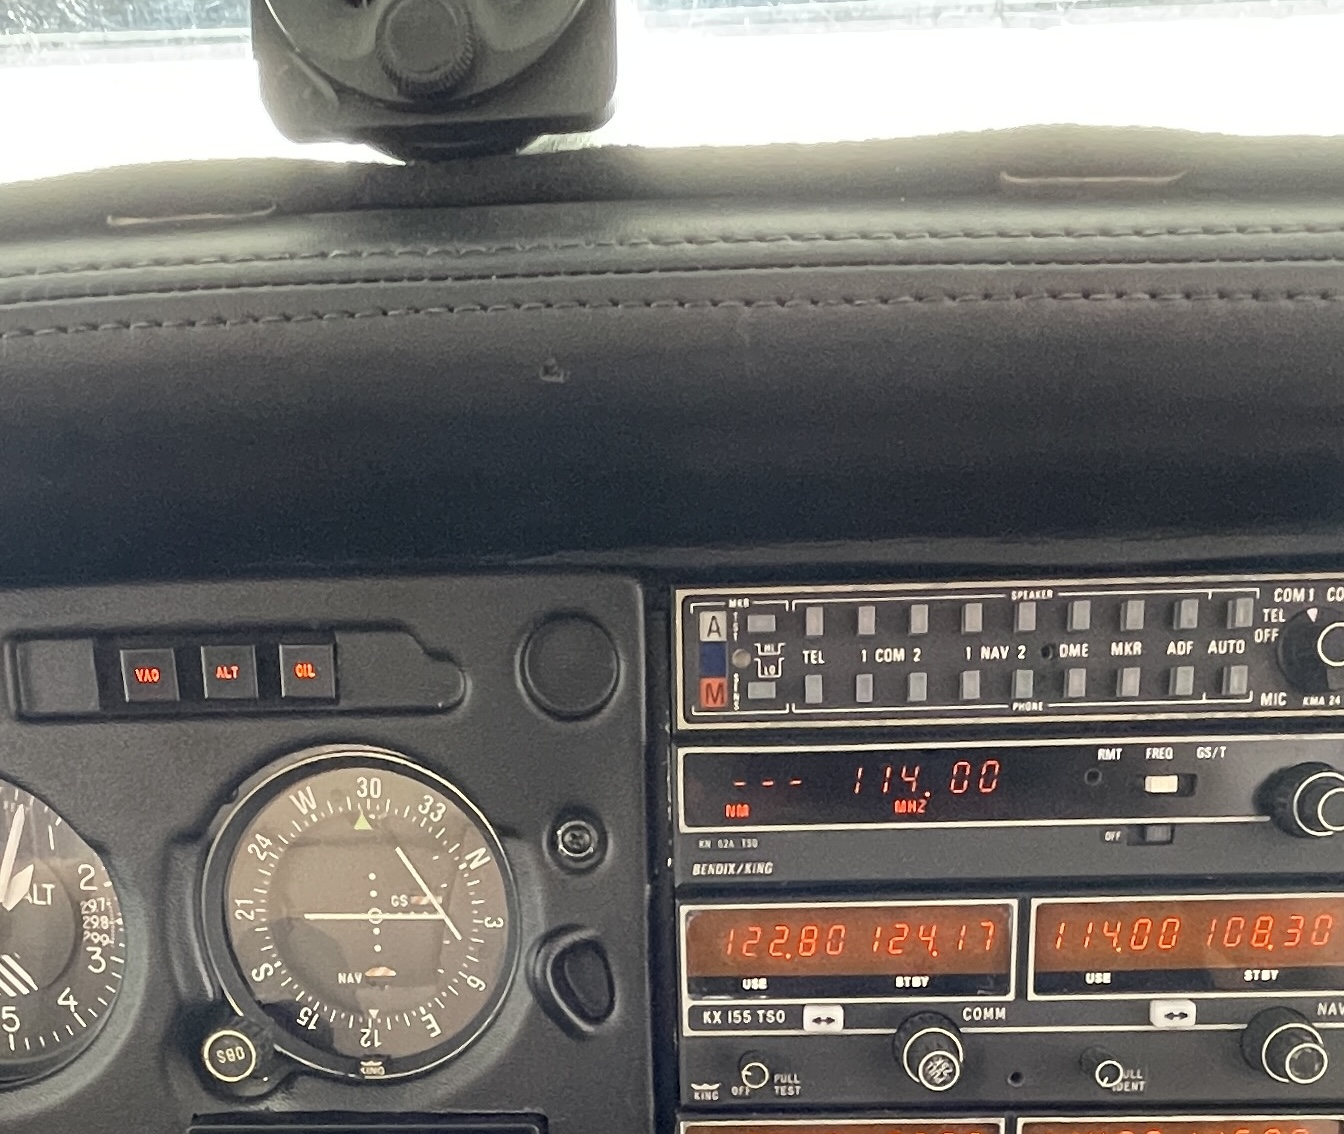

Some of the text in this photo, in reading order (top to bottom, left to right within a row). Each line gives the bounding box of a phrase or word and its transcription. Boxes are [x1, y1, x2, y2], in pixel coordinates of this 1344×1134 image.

[1010, 588, 1054, 602] SPEAKER
[1274, 588, 1314, 602] COM 1
[1262, 609, 1286, 622] TEL
[1254, 628, 1280, 643] OFF
[965, 646, 1026, 660] 1 NAV 2
[1059, 644, 1089, 658] DME
[1110, 642, 1142, 656] MKR
[1167, 641, 1194, 656] ADF
[1207, 640, 1246, 655] AUTO
[802, 650, 825, 665] TEL
[861, 648, 922, 663] 1 COM 2
[215, 665, 239, 679] ALT
[295, 663, 316, 679] OIL
[1260, 692, 1287, 707] MIC
[1097, 748, 1123, 761] RMT
[1145, 746, 1173, 761] FREQ
[1196, 746, 1227, 760] GS/T
[854, 759, 1000, 799] 114.00
[356, 777, 382, 799] 30
[417, 795, 446, 823] 33
[724, 804, 751, 818] NM
[894, 798, 926, 814] MHZ
[691, 862, 774, 876] BENDIX/KING
[78, 864, 98, 891] 2
[390, 894, 409, 907] GS
[726, 920, 996, 960] 122.80 124.17
[1055, 914, 1334, 953] 114.00 108.30
[338, 973, 363, 984] NAV
[1243, 969, 1279, 982] STBY
[1, 1006, 20, 1032] 5
[702, 1009, 786, 1024] KX 155 TSO
[962, 1006, 1007, 1021] COMM
